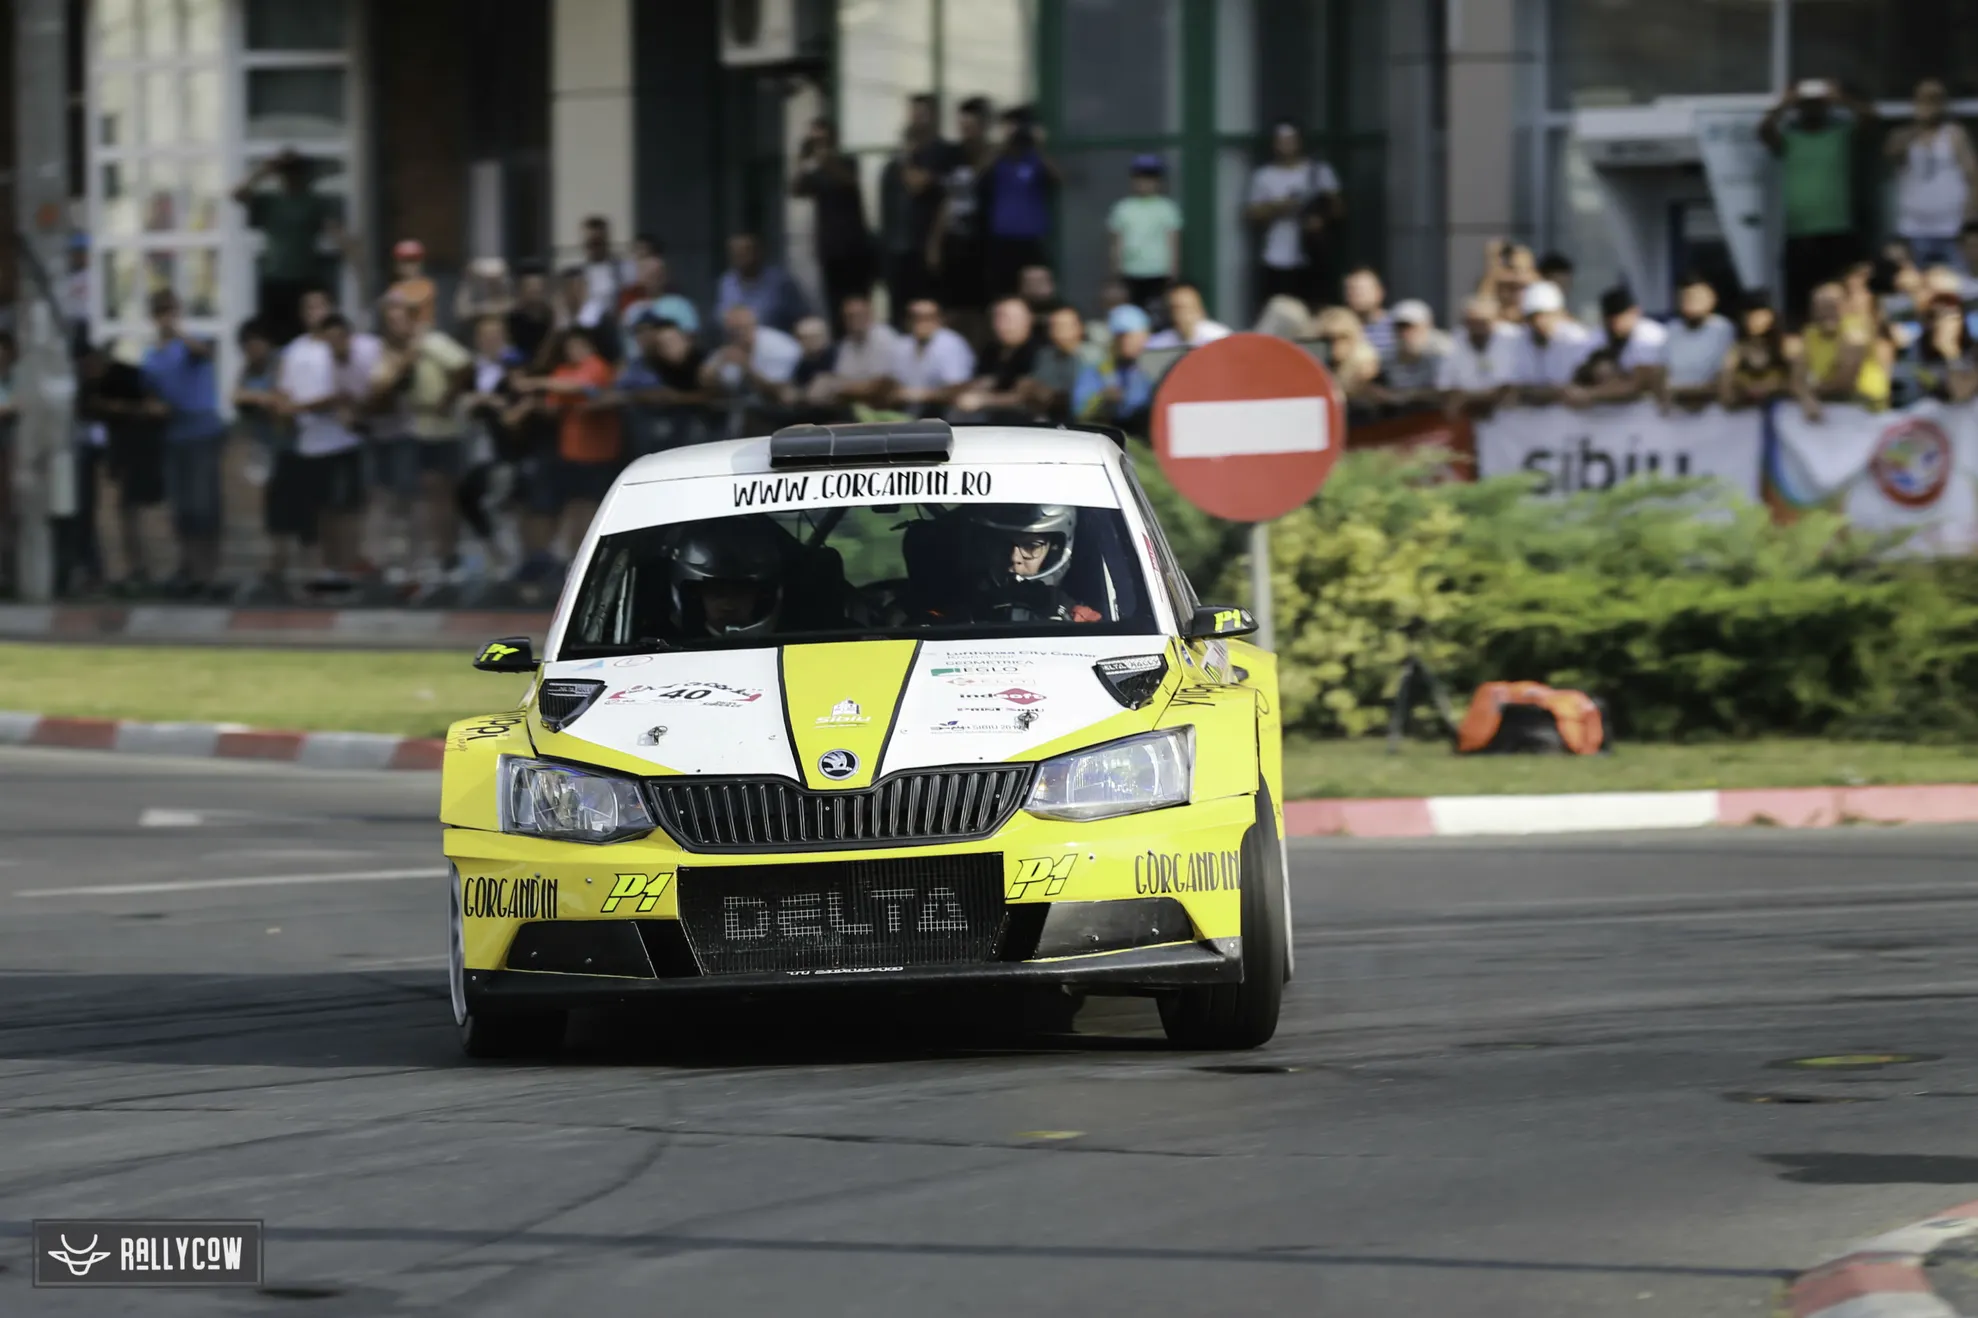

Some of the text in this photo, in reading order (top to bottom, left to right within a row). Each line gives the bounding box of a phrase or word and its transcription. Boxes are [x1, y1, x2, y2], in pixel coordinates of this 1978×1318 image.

[658, 689, 712, 700] 40
[600, 873, 675, 913] P1
[1005, 853, 1078, 900] P1
[1134, 850, 1241, 894] GORGANDIN
[463, 877, 558, 918] GORGANDIN
[723, 887, 968, 940] DELTA
